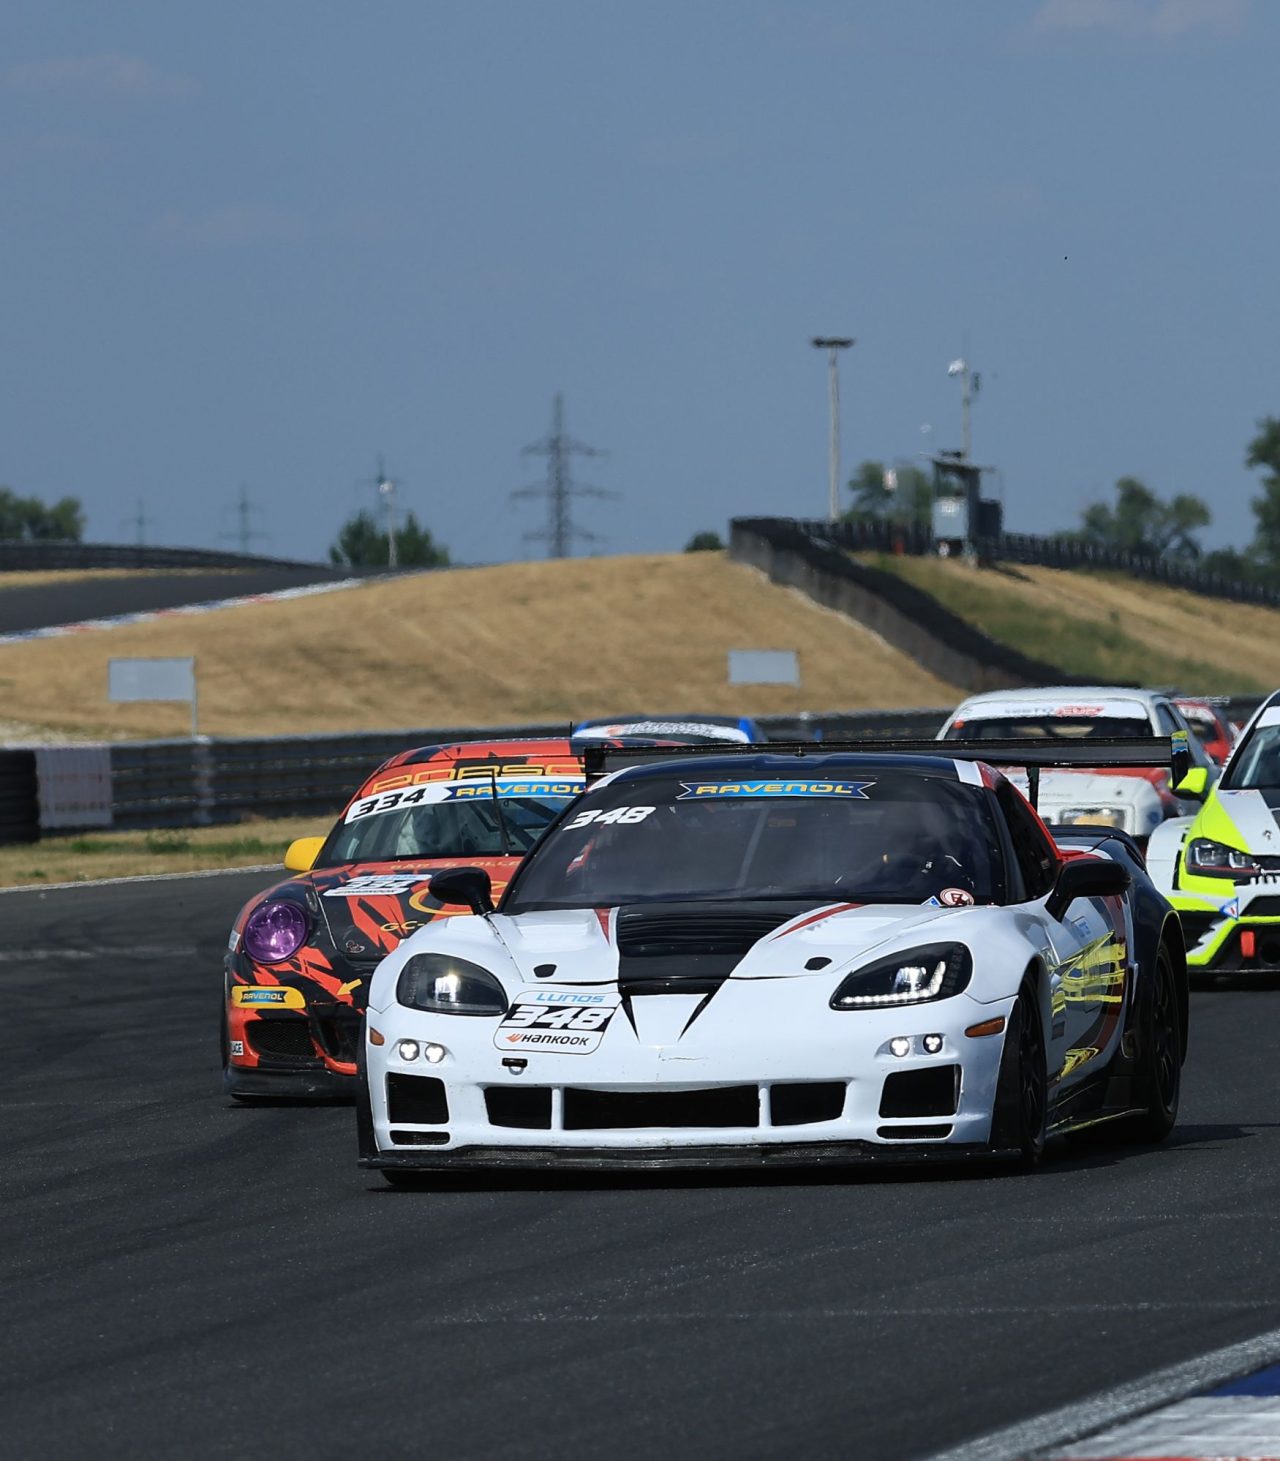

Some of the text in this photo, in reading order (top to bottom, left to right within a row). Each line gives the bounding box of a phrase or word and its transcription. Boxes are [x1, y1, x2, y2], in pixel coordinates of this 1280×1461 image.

[695, 783, 853, 795] RAVENOL
[352, 787, 427, 819] 334
[562, 806, 656, 831] 348
[242, 992, 284, 1001] RAVENOL
[536, 993, 605, 1003] LUNOS
[500, 1004, 616, 1030] 348
